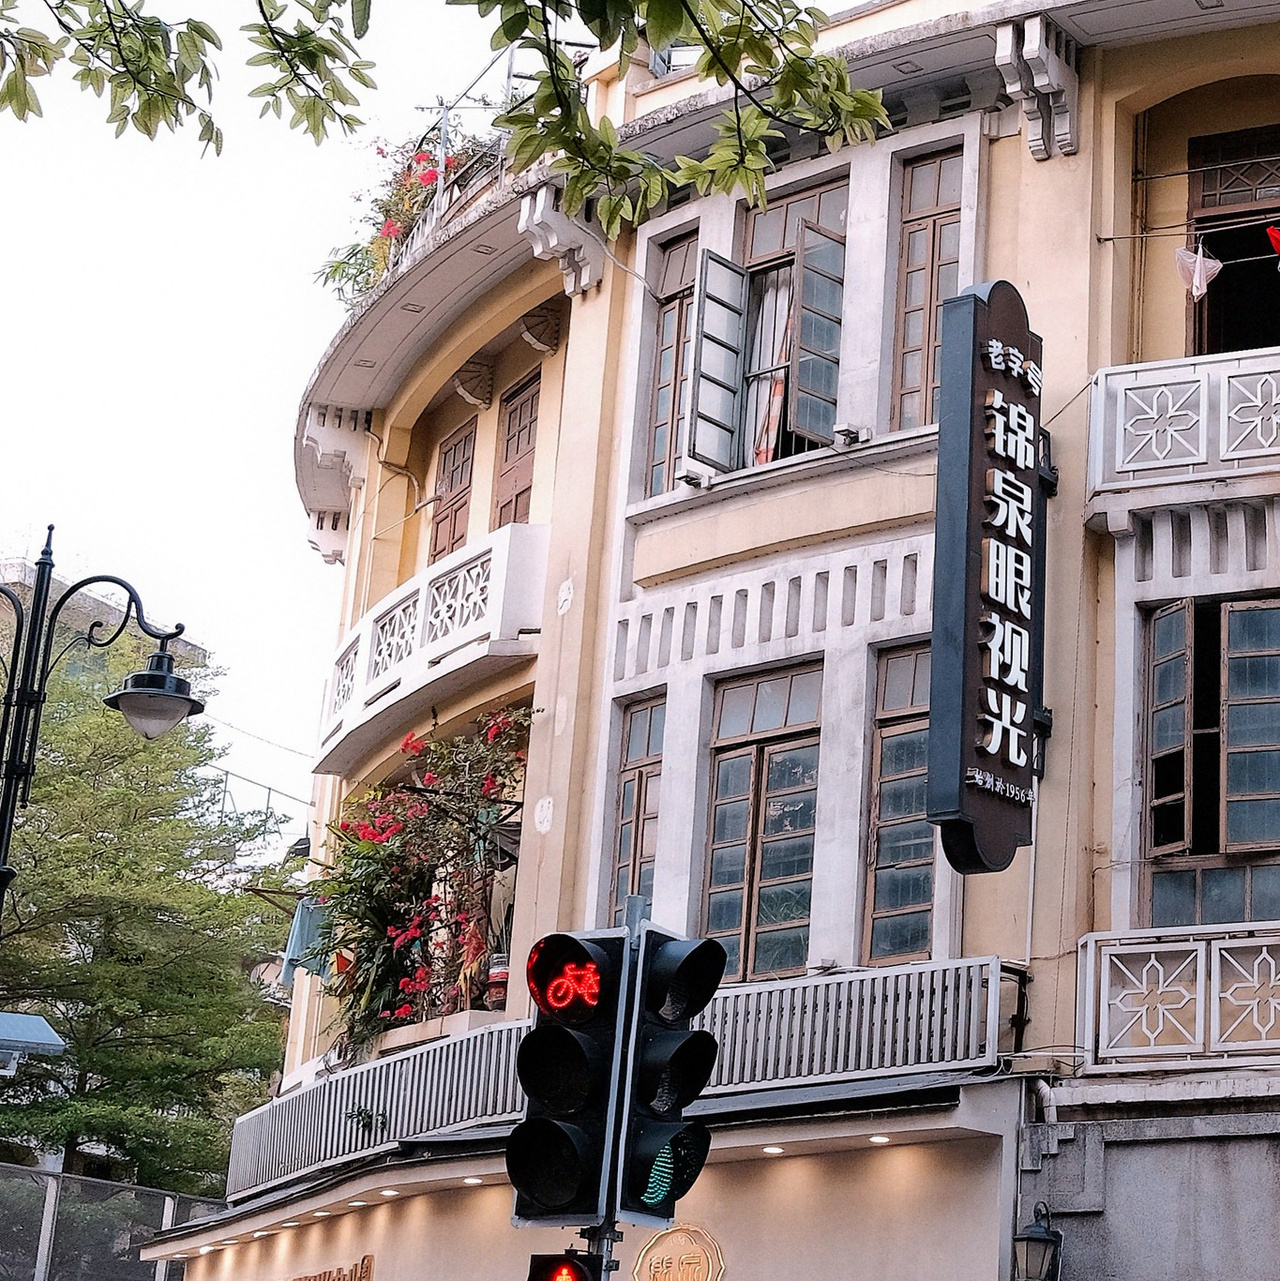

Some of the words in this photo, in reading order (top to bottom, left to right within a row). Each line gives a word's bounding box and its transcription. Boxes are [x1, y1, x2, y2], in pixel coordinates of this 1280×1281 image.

[987, 338, 1043, 397] 老字号
[985, 389, 1035, 768] 锦泉眼视光
